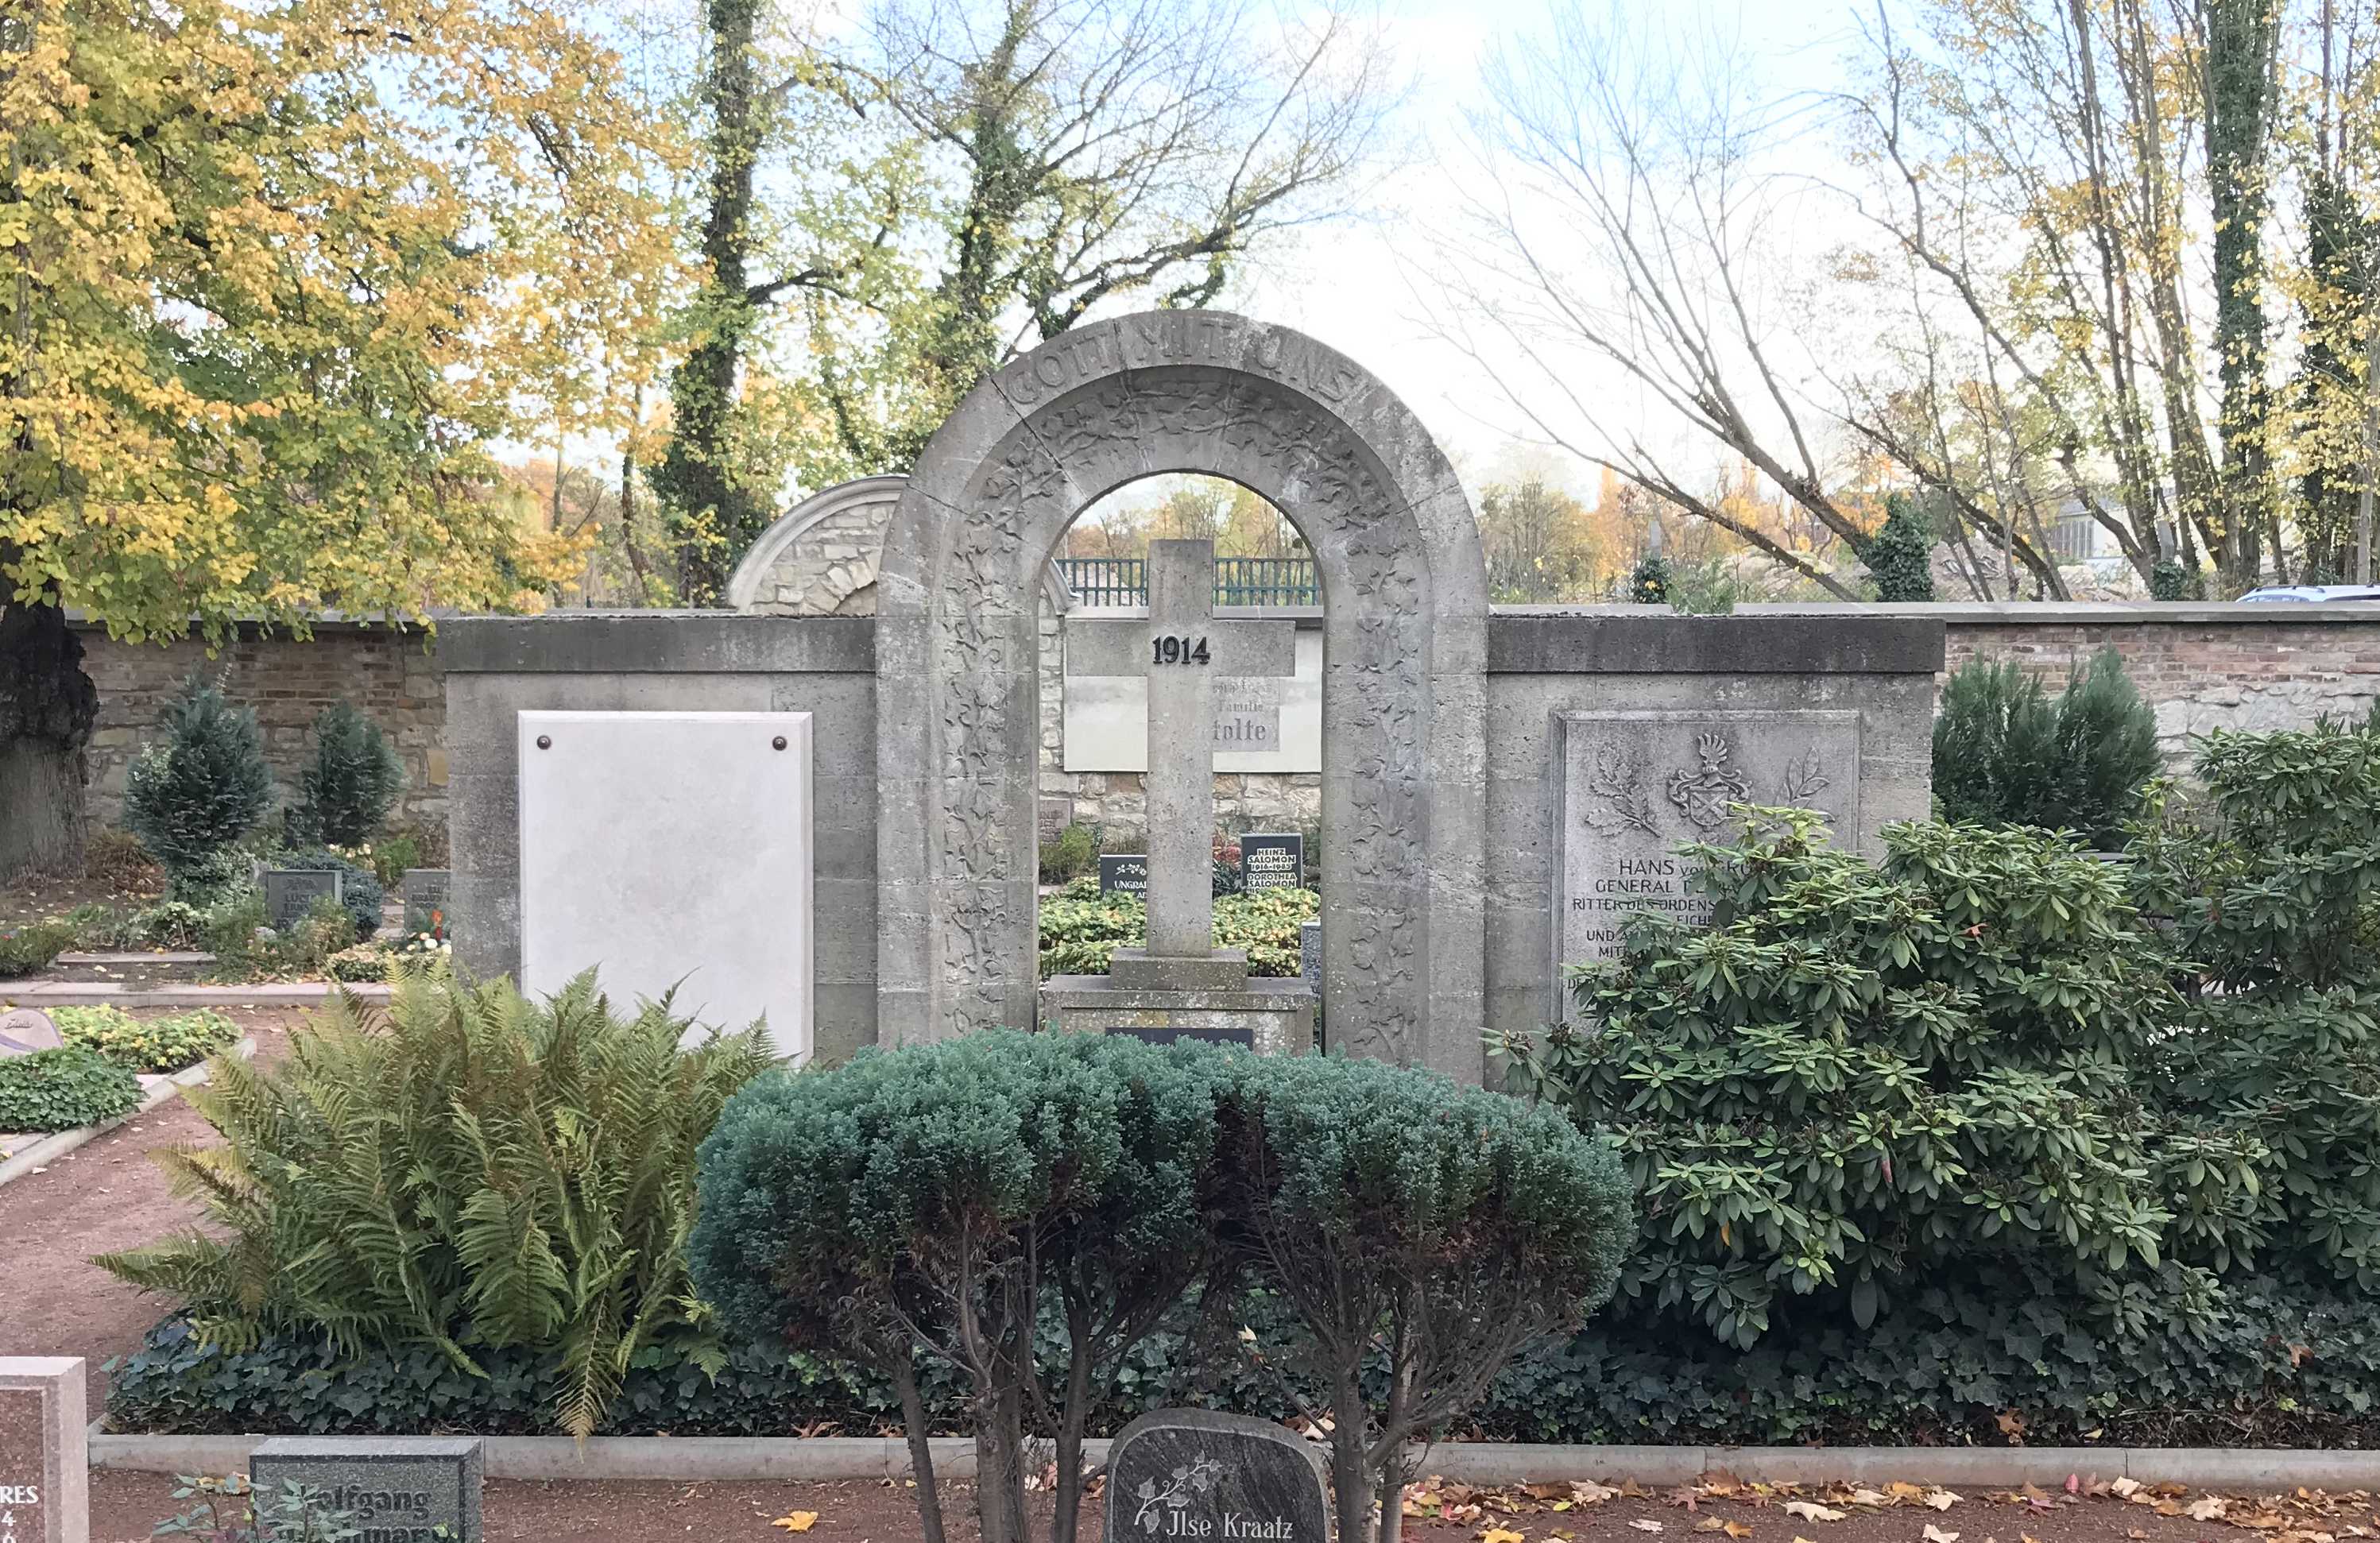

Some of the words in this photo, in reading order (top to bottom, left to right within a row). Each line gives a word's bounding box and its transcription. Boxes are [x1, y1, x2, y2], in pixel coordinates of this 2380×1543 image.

[1005, 332, 1114, 405] GOTT
[1252, 326, 1363, 402] UNS
[1152, 636, 1211, 664] 1914
[1620, 859, 1674, 875] HANS
[1596, 879, 1673, 893] GENERAL
[1573, 898, 1623, 911] RITTER
[1586, 929, 1616, 942] UND
[1224, 1512, 1294, 1540] Kraatz
